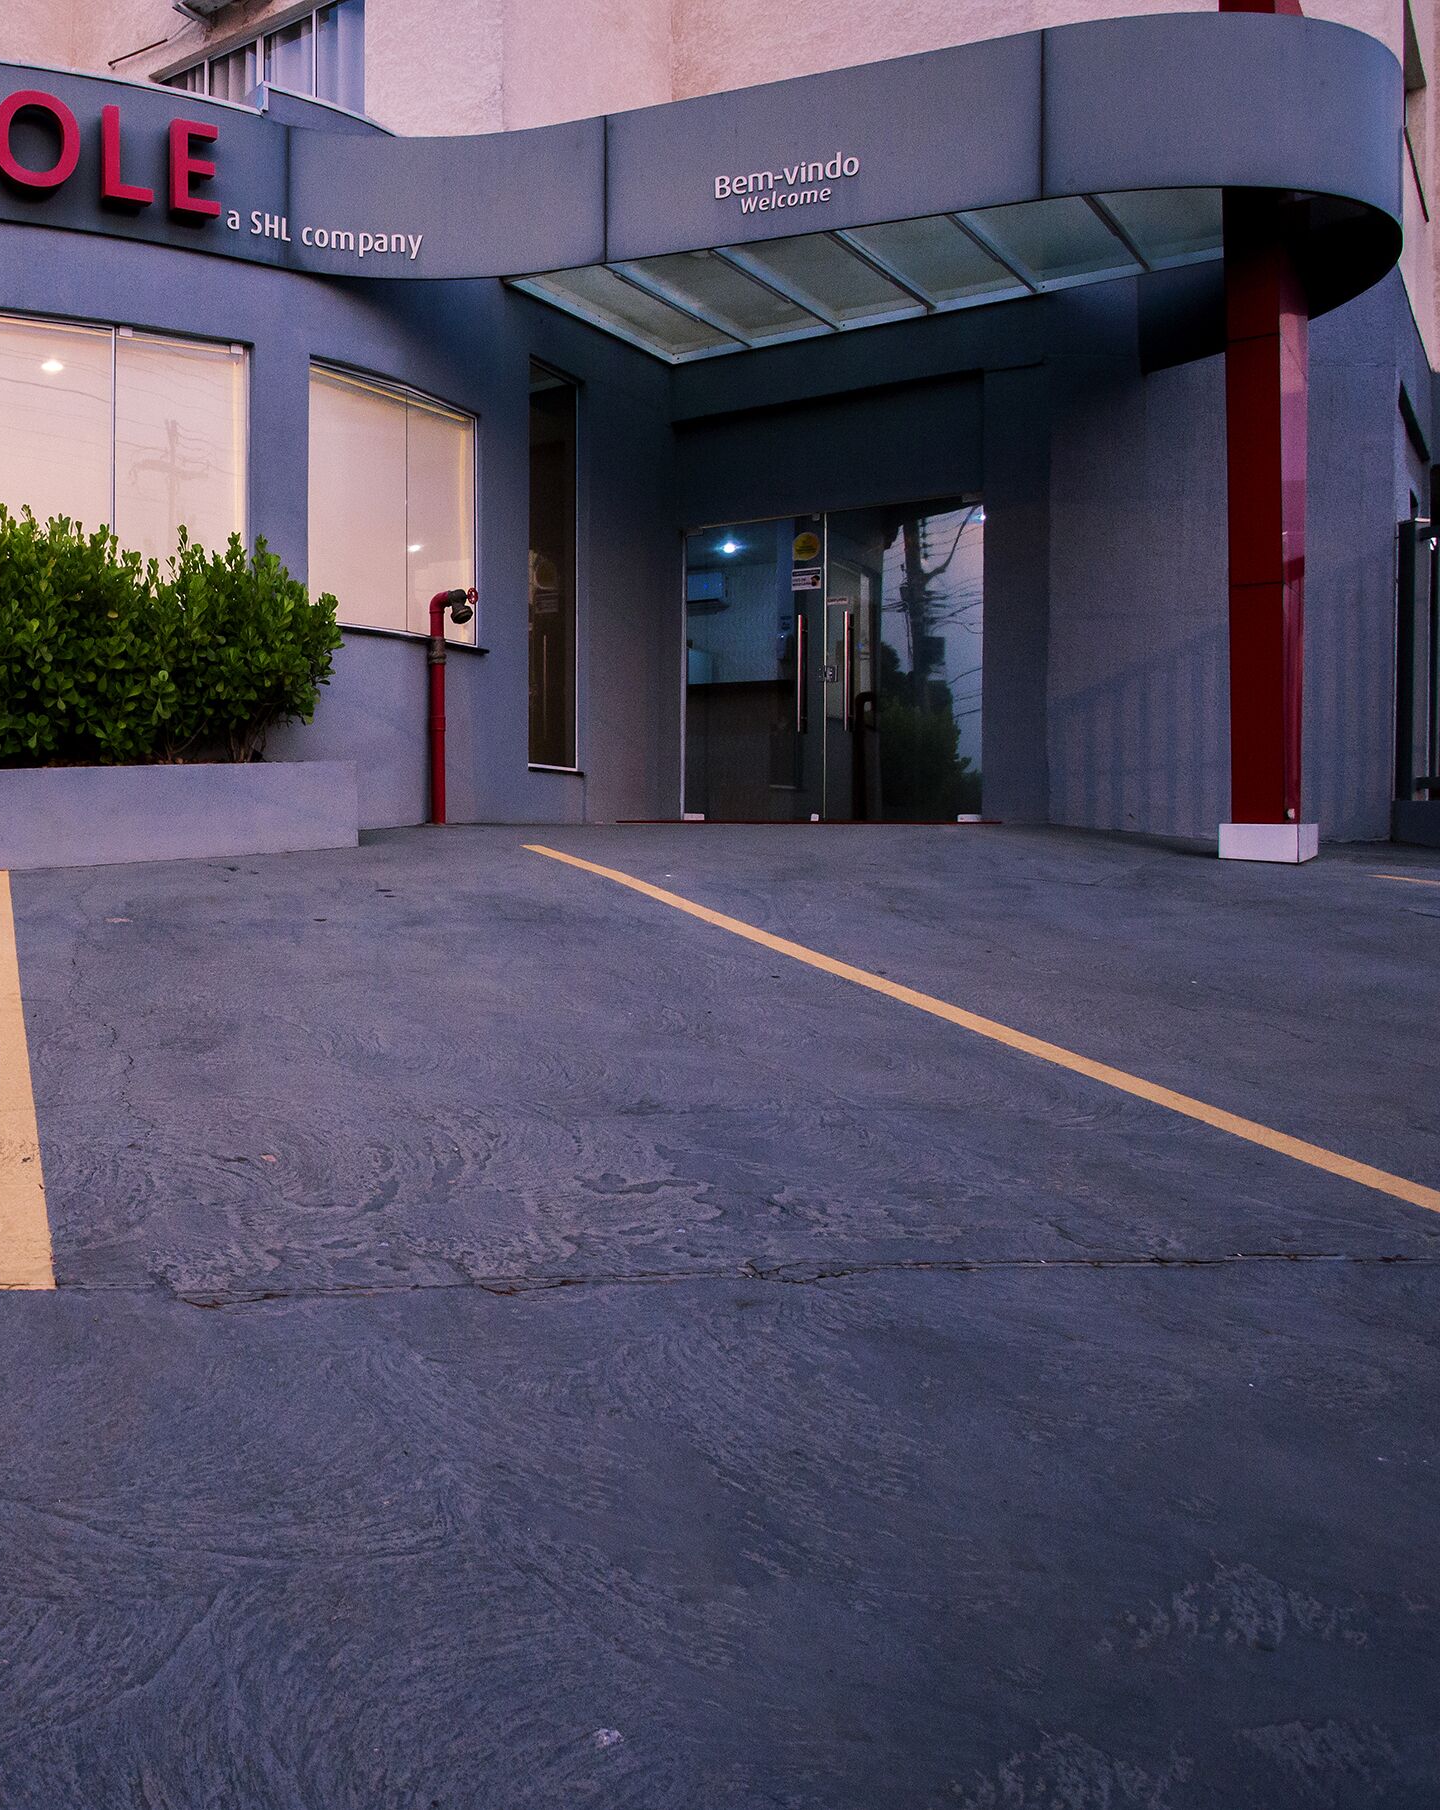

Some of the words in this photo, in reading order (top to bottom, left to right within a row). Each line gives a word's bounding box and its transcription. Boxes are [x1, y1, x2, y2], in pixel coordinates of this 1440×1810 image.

[714, 151, 860, 199] Bem-vindo
[741, 187, 832, 215] Welcome
[226, 209, 240, 230] a
[250, 210, 291, 242] SHL
[301, 226, 424, 260] company
